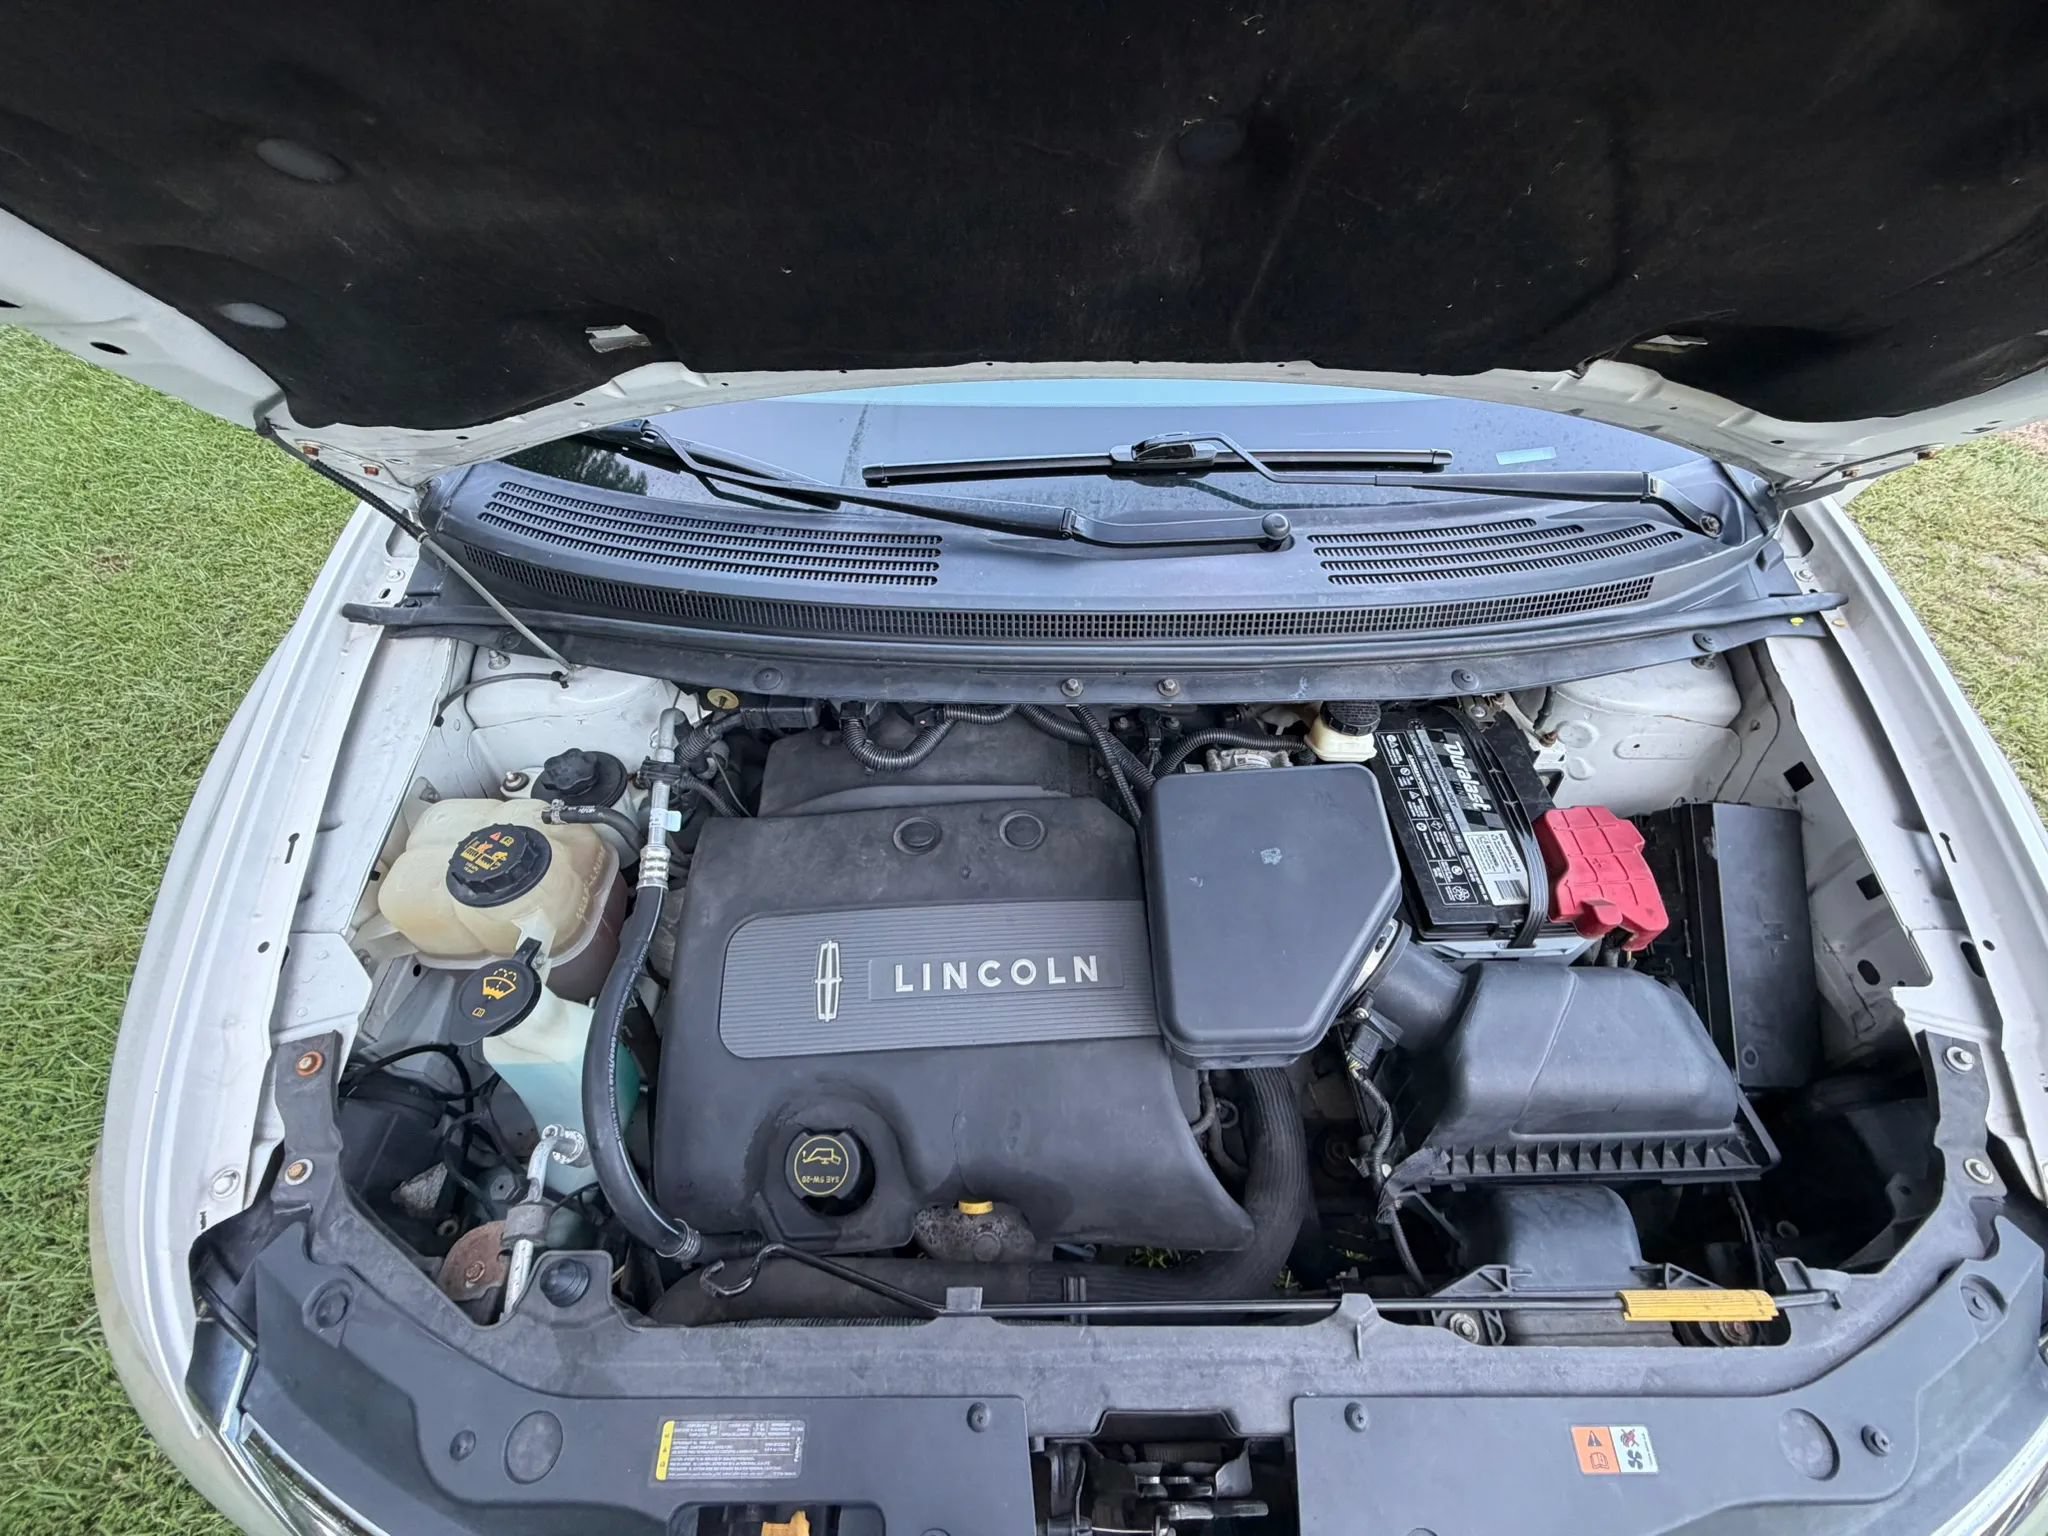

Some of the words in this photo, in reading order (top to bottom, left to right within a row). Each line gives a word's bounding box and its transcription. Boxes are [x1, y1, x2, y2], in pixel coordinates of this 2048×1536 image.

[1443, 740, 1492, 811] Duralast
[895, 955, 1099, 992] LINCOLN
[801, 1175, 825, 1184] 5W-20
[826, 1175, 840, 1184] SAE
